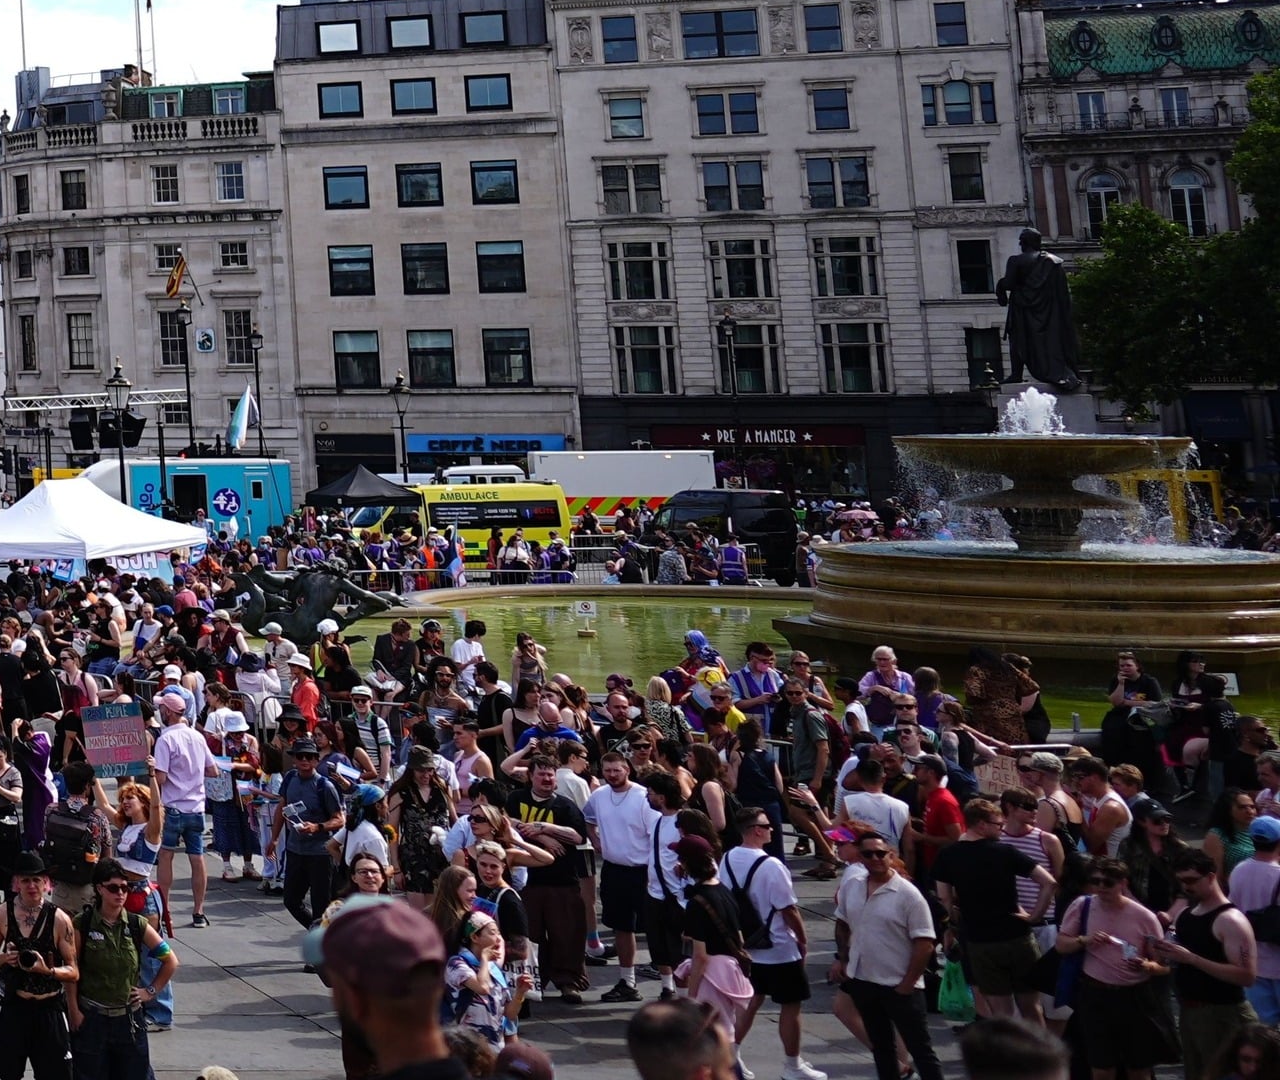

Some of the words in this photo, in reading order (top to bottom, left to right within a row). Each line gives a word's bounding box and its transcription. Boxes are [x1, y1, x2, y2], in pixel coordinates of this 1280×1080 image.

[716, 428, 737, 443] PRE
[744, 429, 751, 443] A
[754, 429, 796, 443] MANGER
[491, 439, 541, 451] NERO
[439, 491, 499, 501] AMBULANCE
[105, 704, 129, 719] PEOPLE
[89, 731, 143, 749] MANIFESTATIONS
[101, 763, 129, 778] SOCIETY
